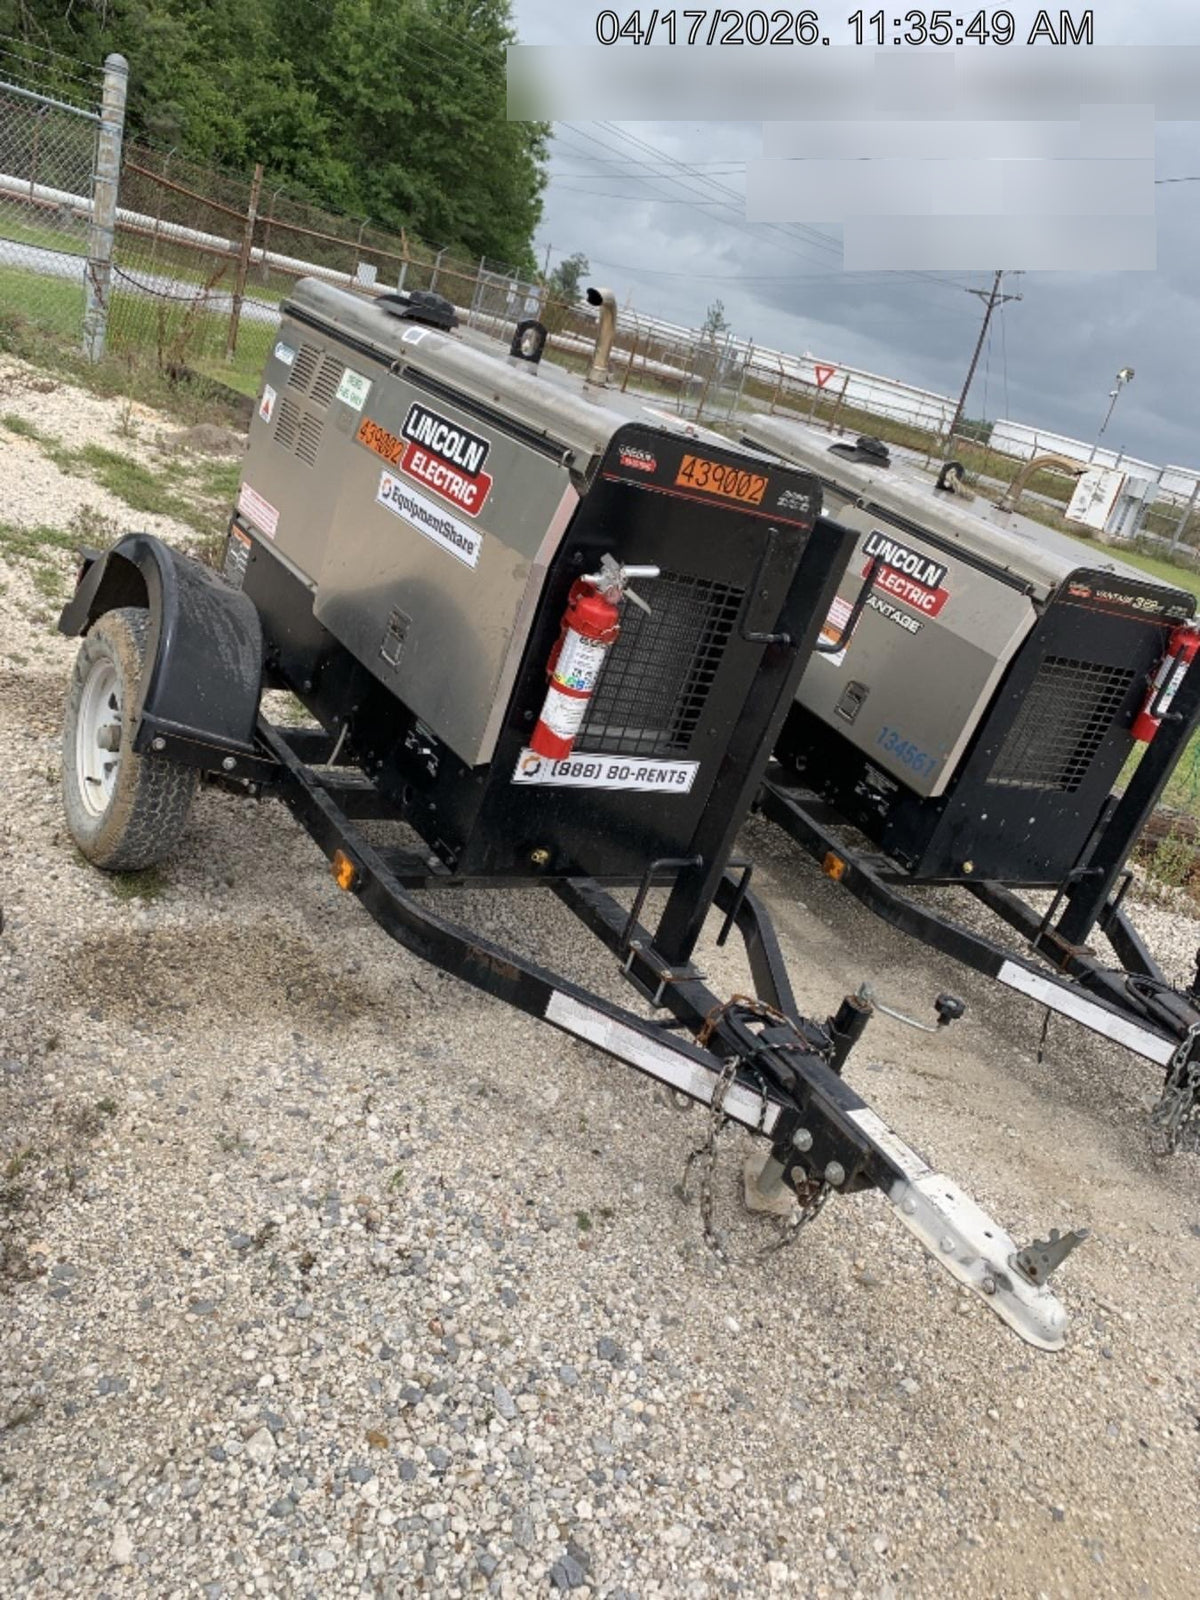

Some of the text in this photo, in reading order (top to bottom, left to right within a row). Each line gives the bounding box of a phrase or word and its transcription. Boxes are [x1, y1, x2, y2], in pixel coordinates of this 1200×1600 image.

[406, 409, 484, 473] LINCOLN
[410, 451, 477, 506] ELECTRIC
[681, 458, 766, 501] 439002
[391, 485, 475, 556] EquipmentShare
[866, 534, 941, 586] LINCOLN
[865, 593, 921, 633] ANTAGE
[551, 760, 603, 780] (888)
[876, 726, 937, 777] 134561
